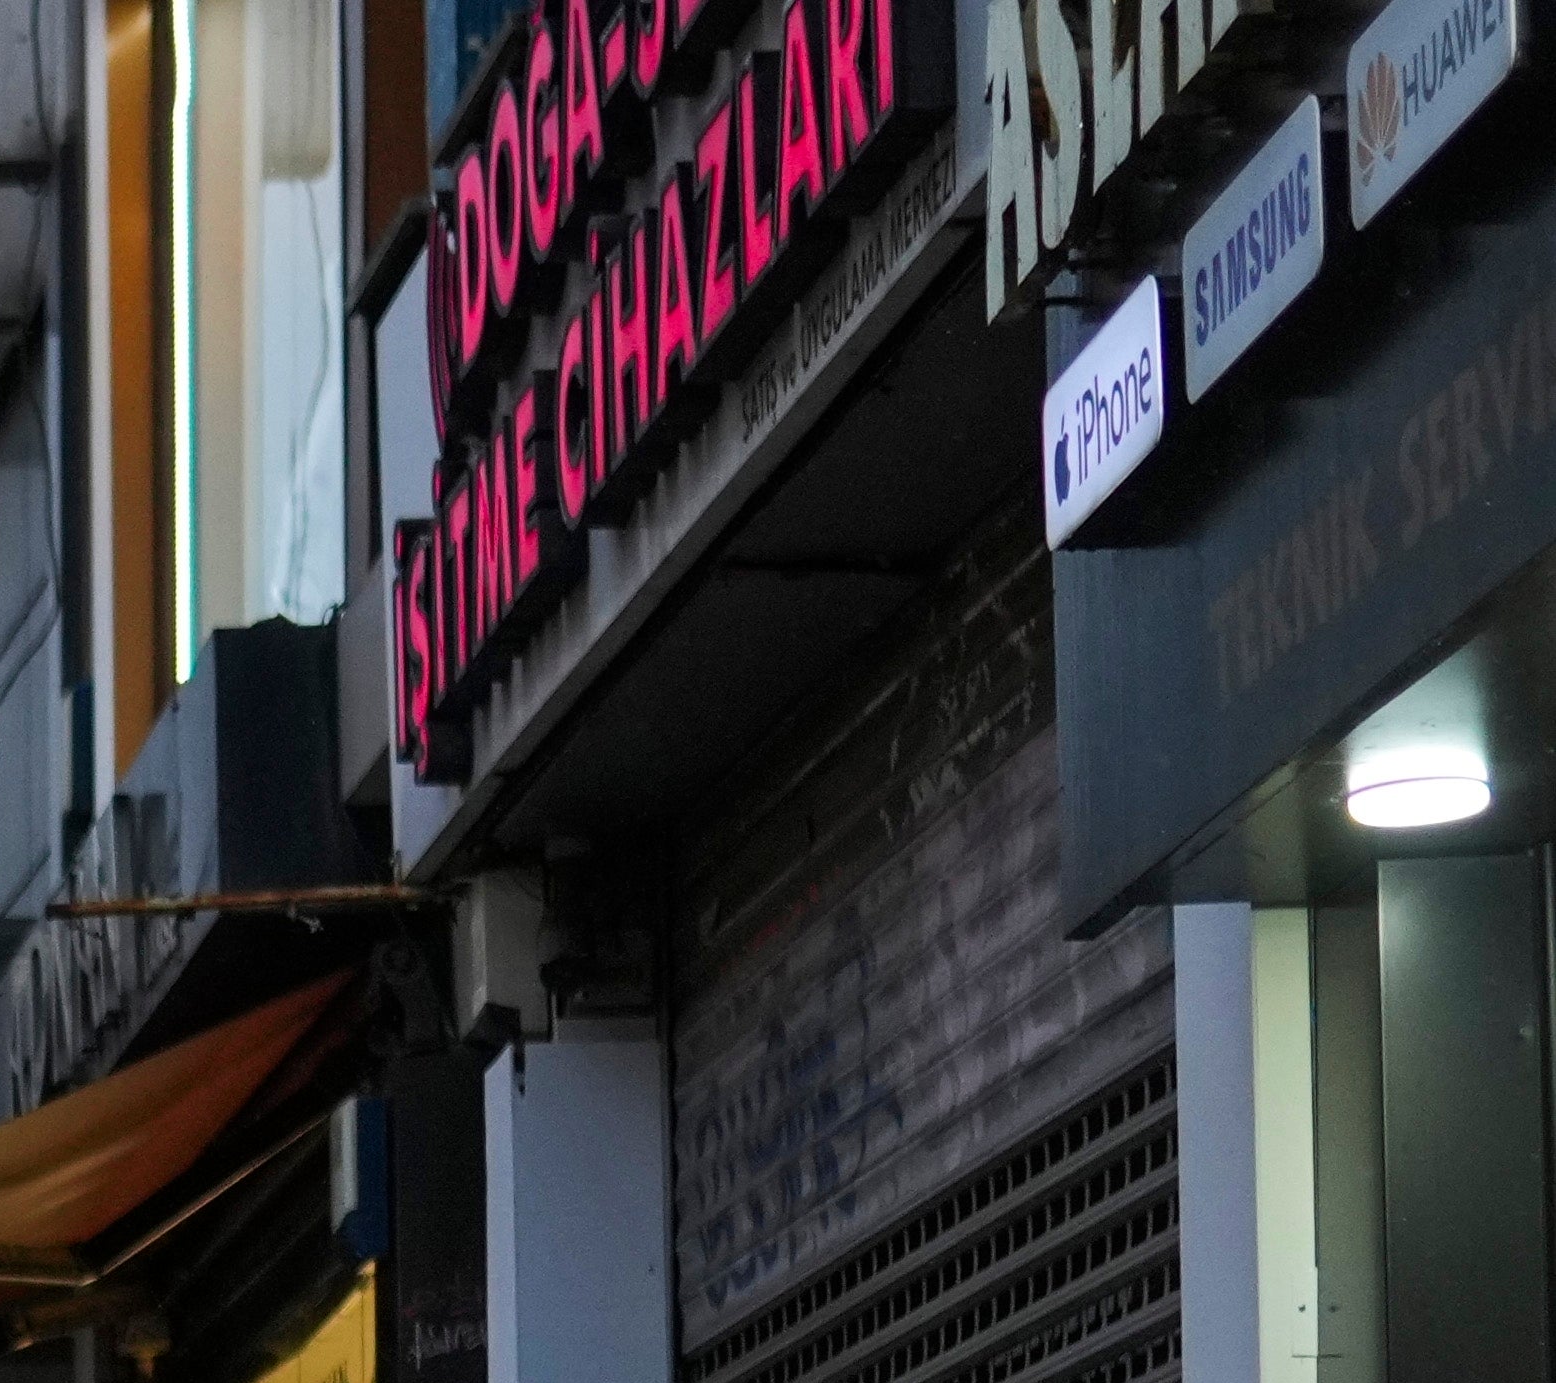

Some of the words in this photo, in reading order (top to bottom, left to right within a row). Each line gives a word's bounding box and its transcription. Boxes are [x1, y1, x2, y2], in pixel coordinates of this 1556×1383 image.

[1195, 153, 1312, 347] SAMSUNG
[1076, 345, 1152, 487] iPhone
[395, 388, 540, 777] İŞİTME
